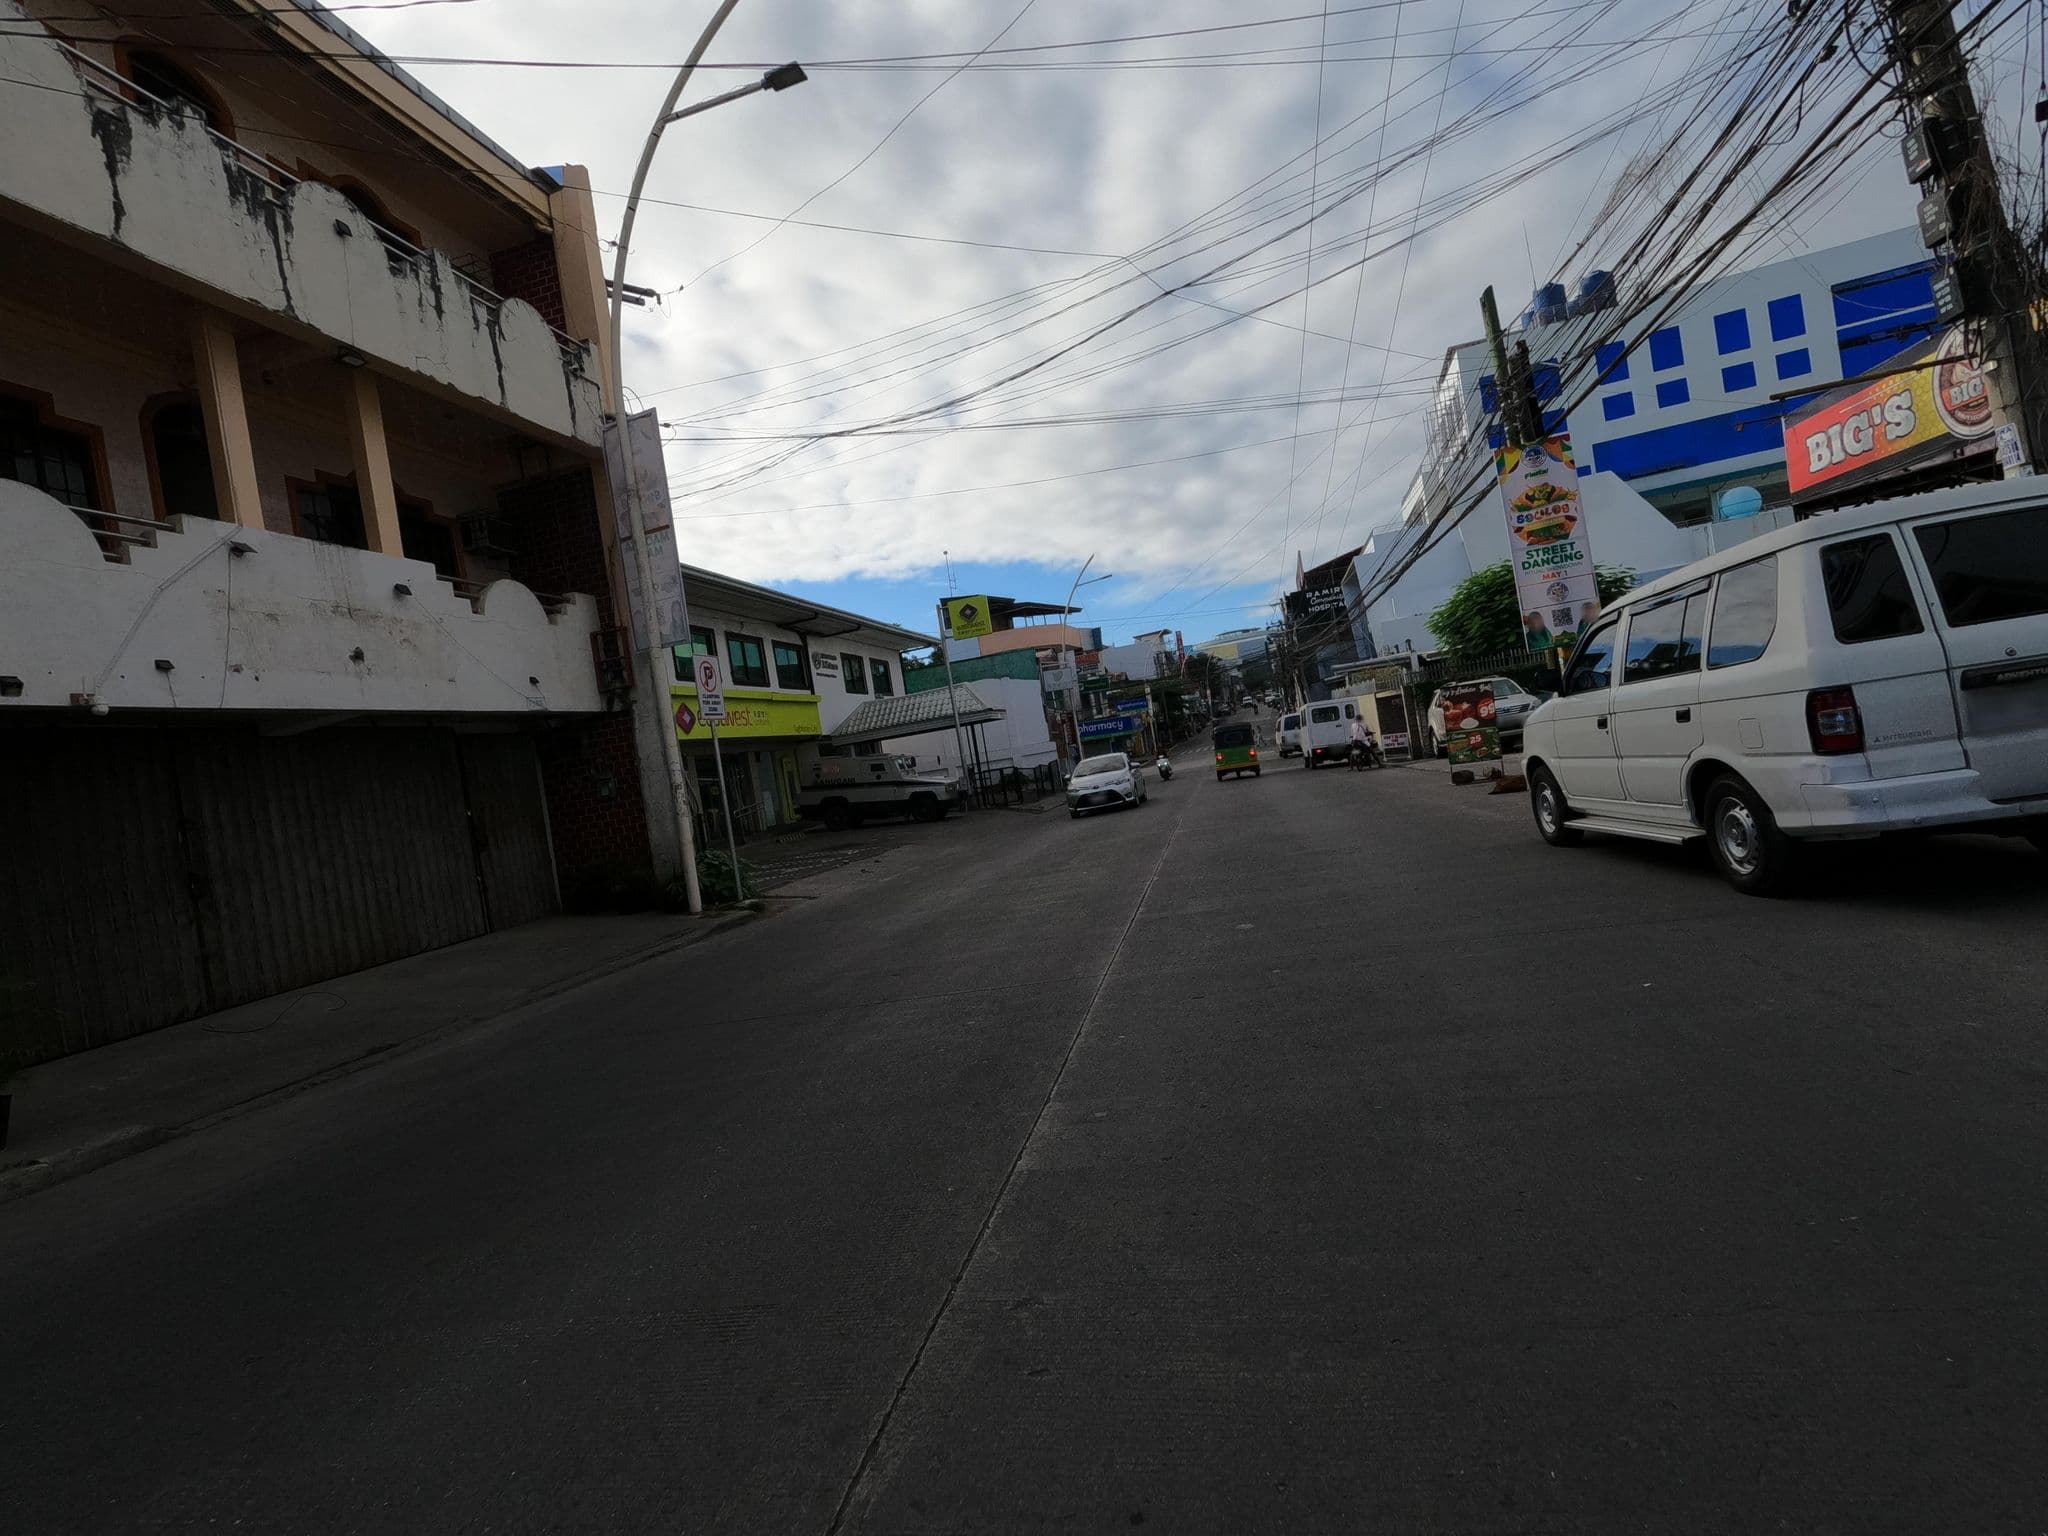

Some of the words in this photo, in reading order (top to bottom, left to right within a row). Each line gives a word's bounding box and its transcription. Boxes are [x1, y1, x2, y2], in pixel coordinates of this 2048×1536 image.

[1949, 377, 1985, 407] BIG
[1806, 388, 1917, 473] BIG'S
[1526, 542, 1576, 560] STREET
[1521, 550, 1585, 570] DANCING
[1542, 570, 1562, 580] MAY
[1306, 586, 1343, 599] RAMIR
[1308, 601, 1345, 614] HOSPITA
[1996, 665, 2048, 681] ADVENTU
[1078, 719, 1123, 733] pharmacy
